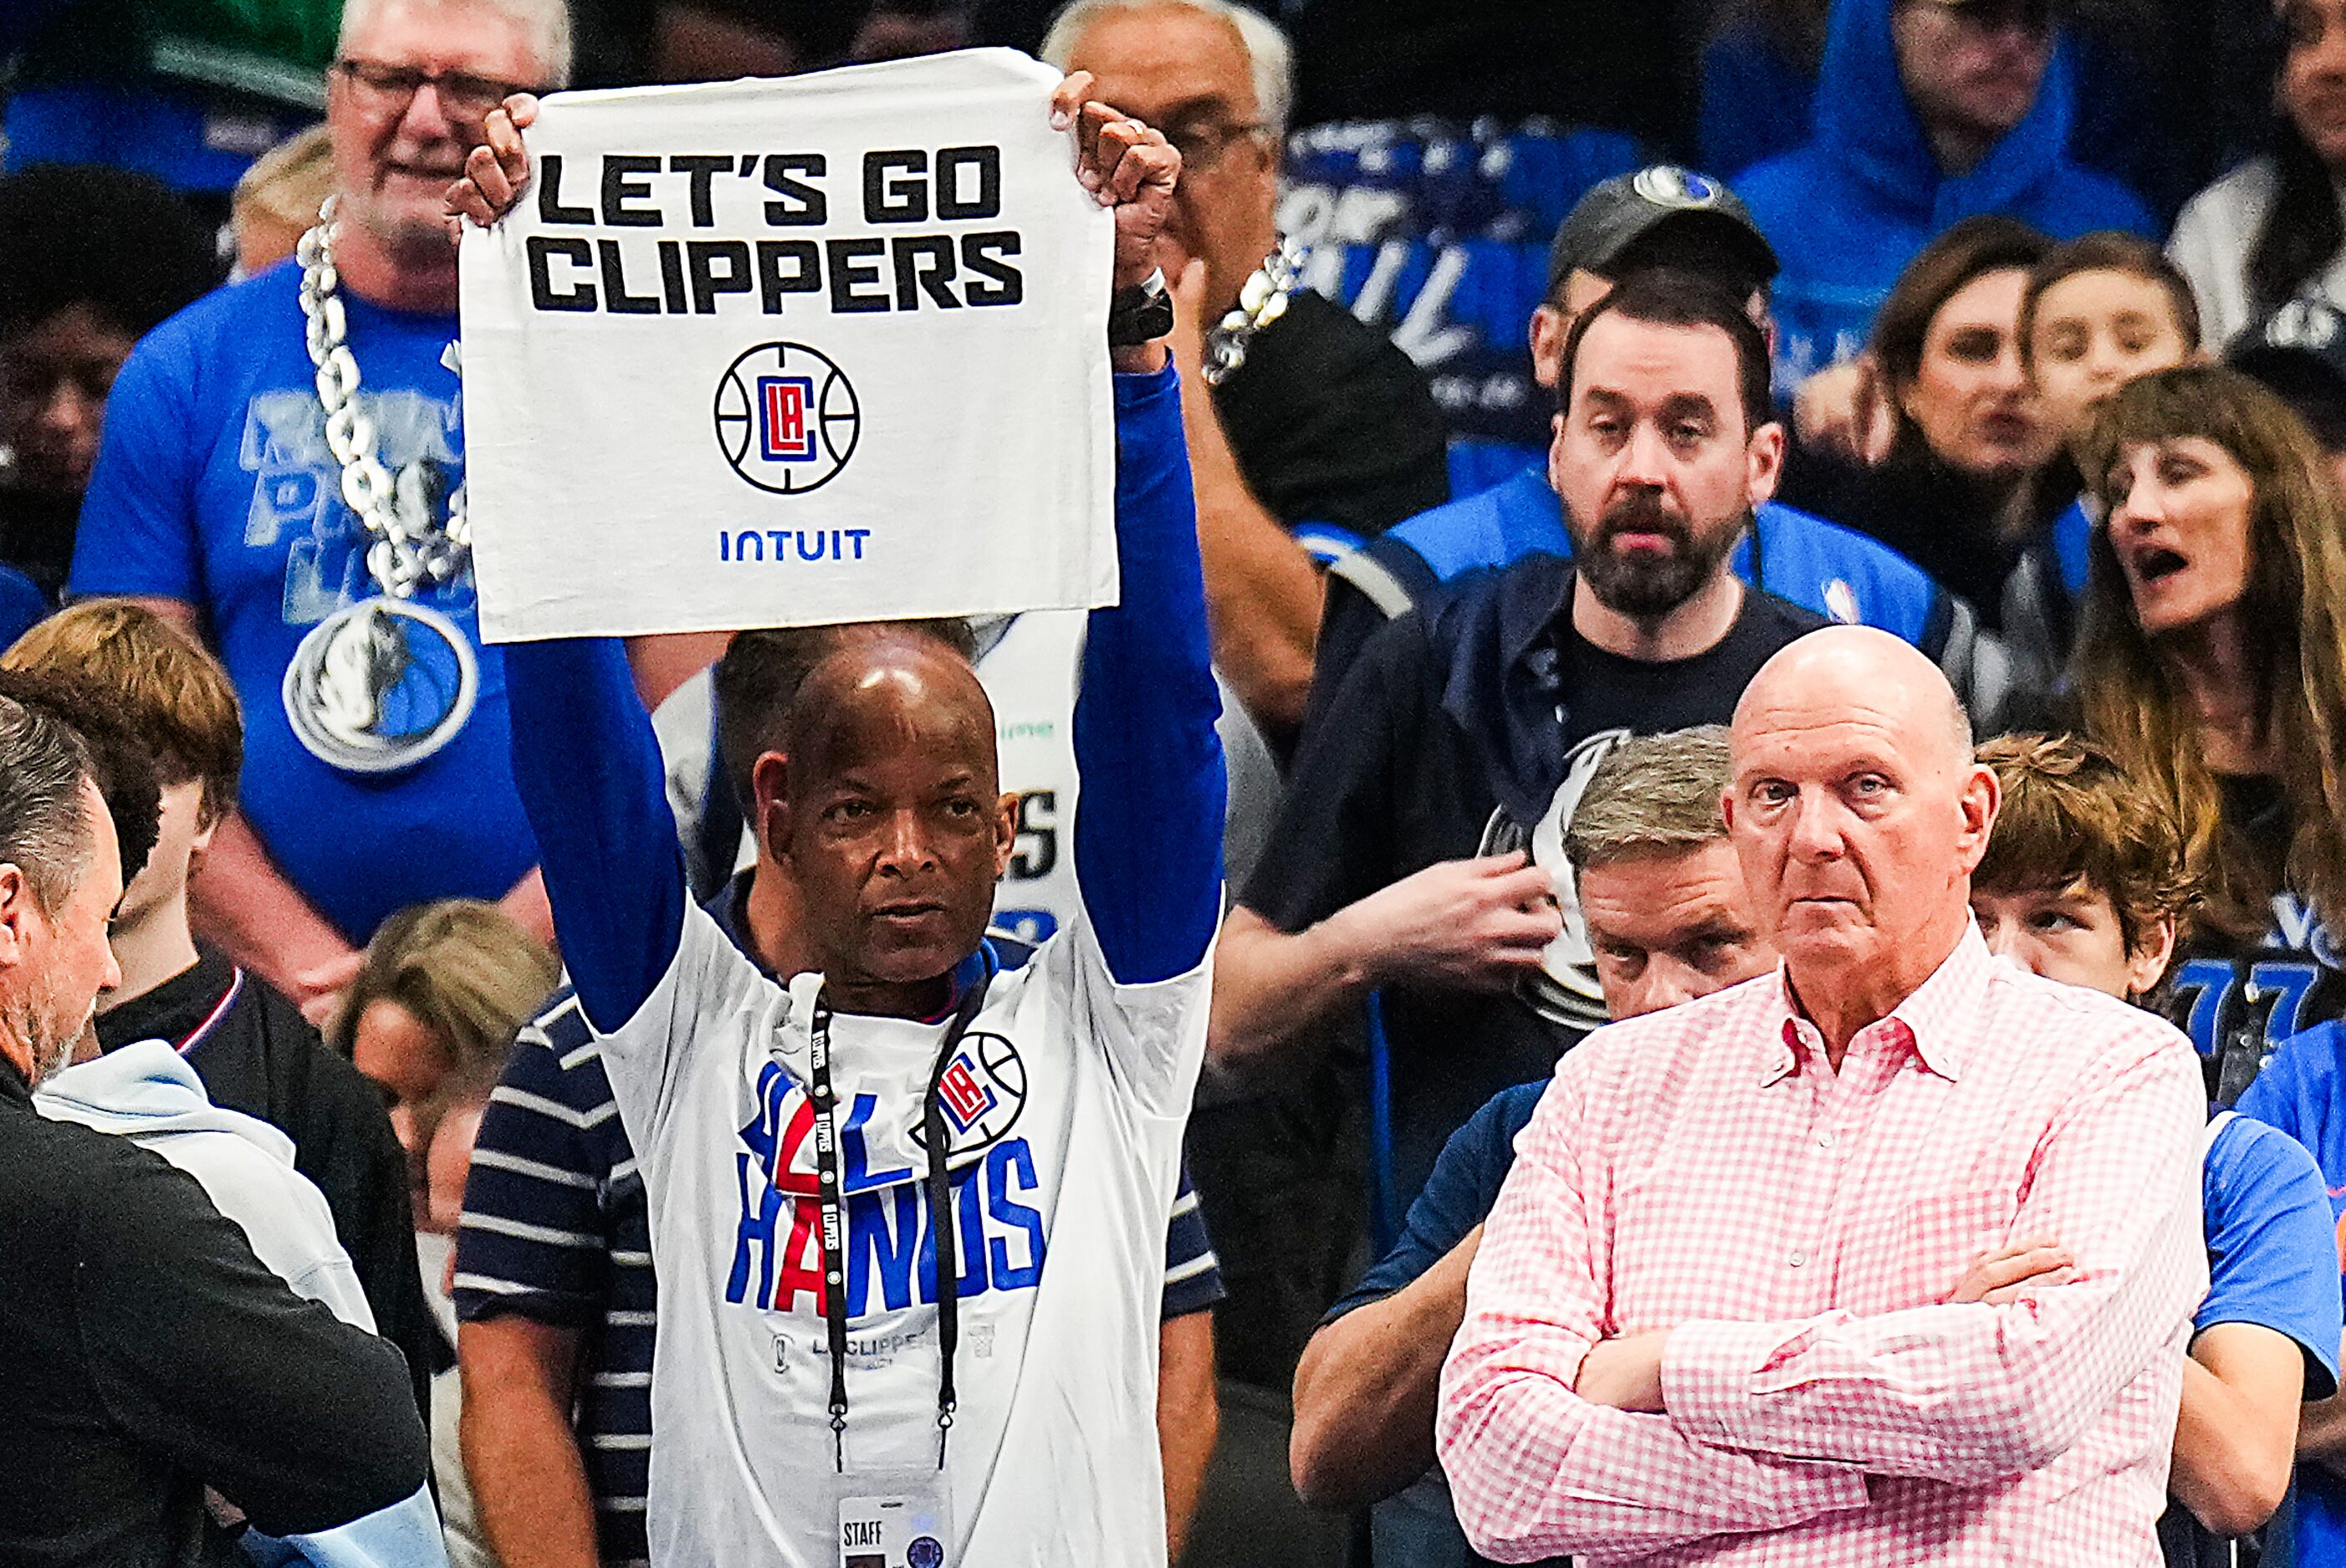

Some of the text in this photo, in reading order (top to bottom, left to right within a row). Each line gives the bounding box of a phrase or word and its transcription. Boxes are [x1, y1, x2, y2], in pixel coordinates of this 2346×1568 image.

[538, 145, 1000, 227] LET'S GO
[526, 230, 1023, 315] CLIPPERS
[720, 529, 871, 561] INTUIT
[2172, 959, 2318, 1057] 77
[726, 1136, 1048, 1318] HANDS
[844, 1520, 882, 1547] STAFF
